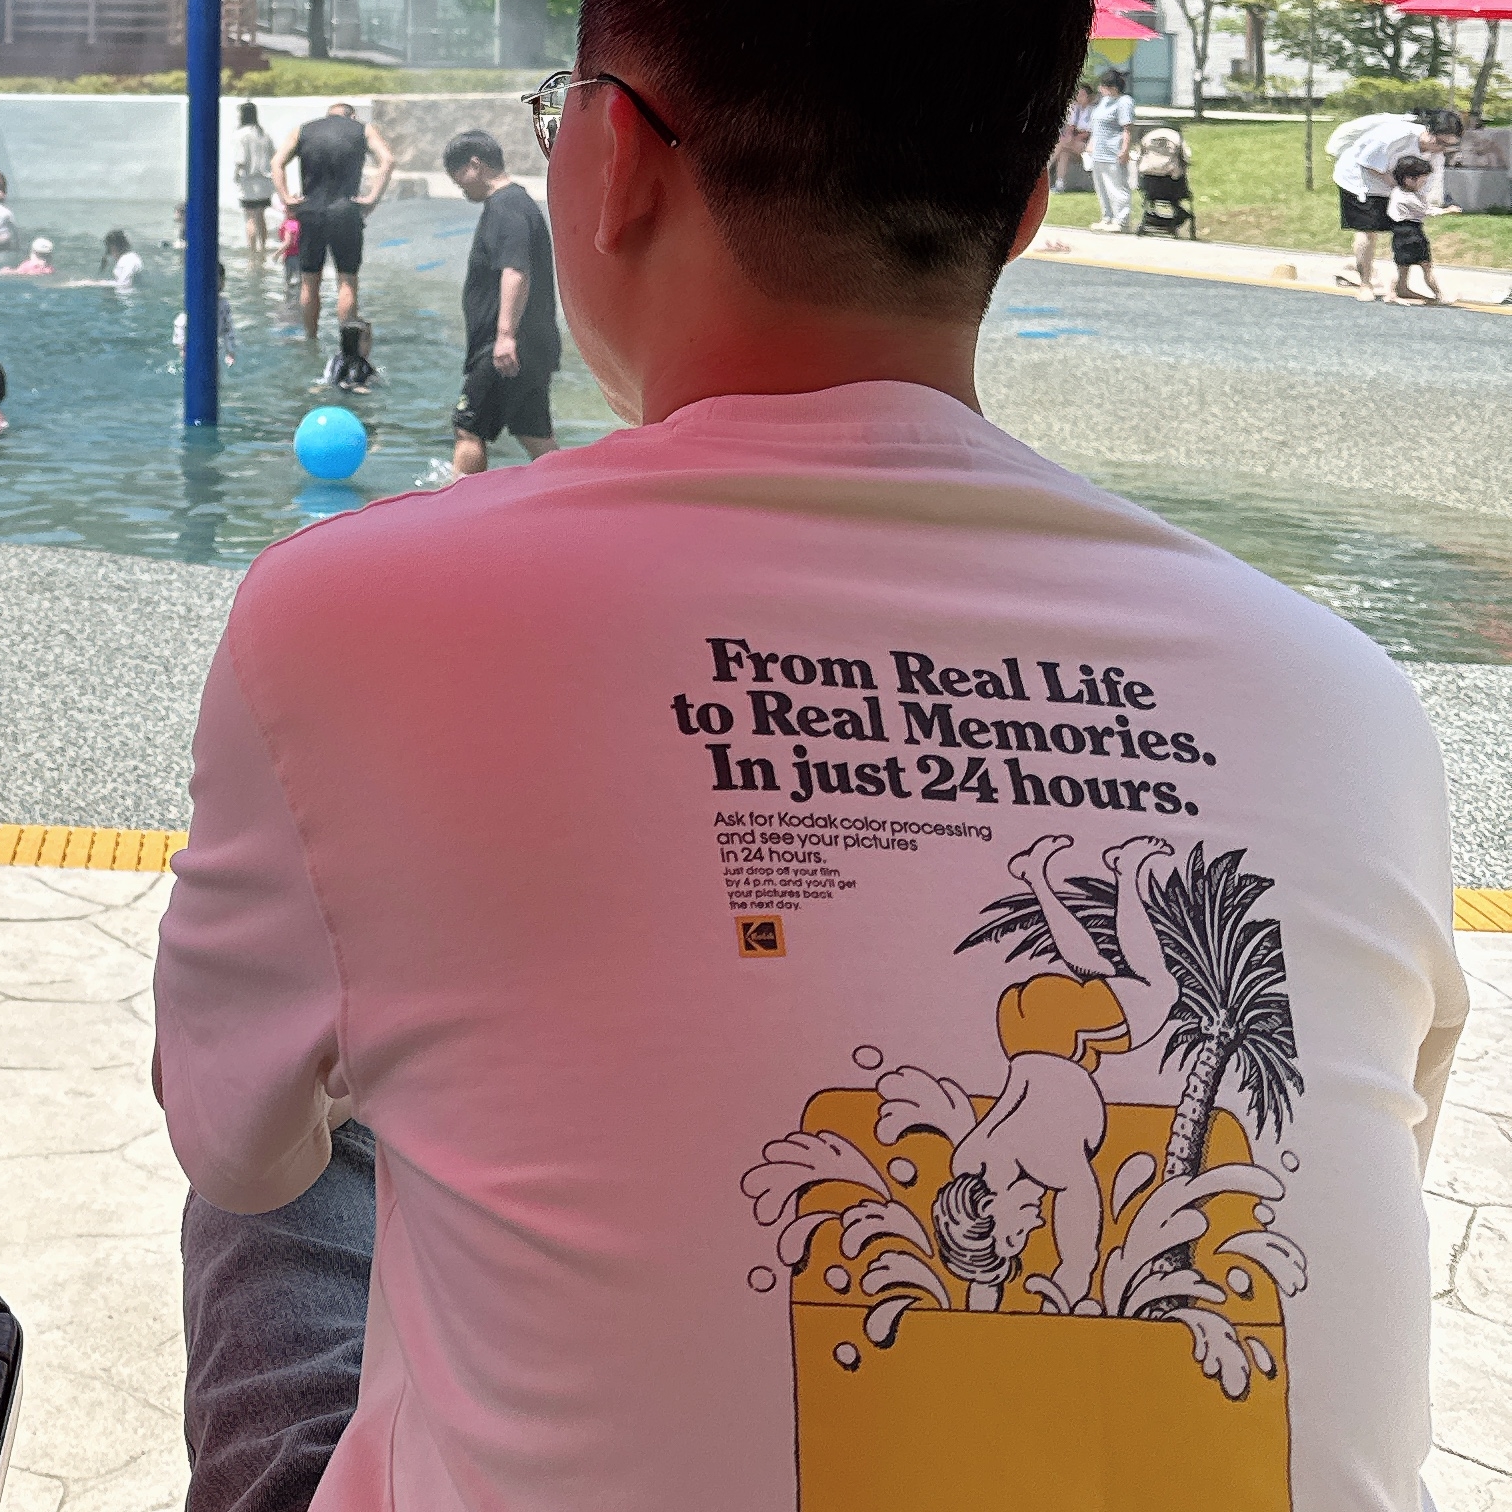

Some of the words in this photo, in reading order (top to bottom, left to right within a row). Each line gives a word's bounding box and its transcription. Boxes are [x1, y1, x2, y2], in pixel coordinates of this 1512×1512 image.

[706, 637, 878, 689] From
[890, 651, 1029, 701] Real
[1037, 661, 1157, 711] Life
[671, 691, 733, 736] to
[747, 690, 889, 743] Real
[898, 701, 1217, 766] Memories.
[706, 743, 777, 791] In
[790, 745, 912, 803] just
[920, 754, 999, 804] 24
[1005, 758, 1200, 816] hours.
[714, 812, 745, 828] Ask
[749, 812, 774, 827] for
[779, 812, 838, 829] Kodak
[840, 816, 887, 832] color
[890, 820, 992, 841] processing
[717, 830, 755, 845] and
[760, 833, 797, 845] see
[799, 834, 839, 848] your
[843, 833, 918, 851] pictures
[742, 848, 764, 862] 24
[769, 848, 827, 864] hours.
[724, 867, 744, 876] Just
[746, 867, 773, 877] drop
[775, 867, 789, 876] off
[793, 868, 818, 878] your
[820, 868, 840, 877] film
[726, 878, 738, 888] by
[743, 878, 750, 887] 4
[780, 878, 802, 887] and
[838, 879, 857, 890] get
[728, 890, 752, 900] your
[755, 889, 801, 900] pictures
[803, 889, 832, 899] back
[730, 901, 747, 910] the
[750, 901, 774, 910] next
[776, 901, 801, 911] day.
